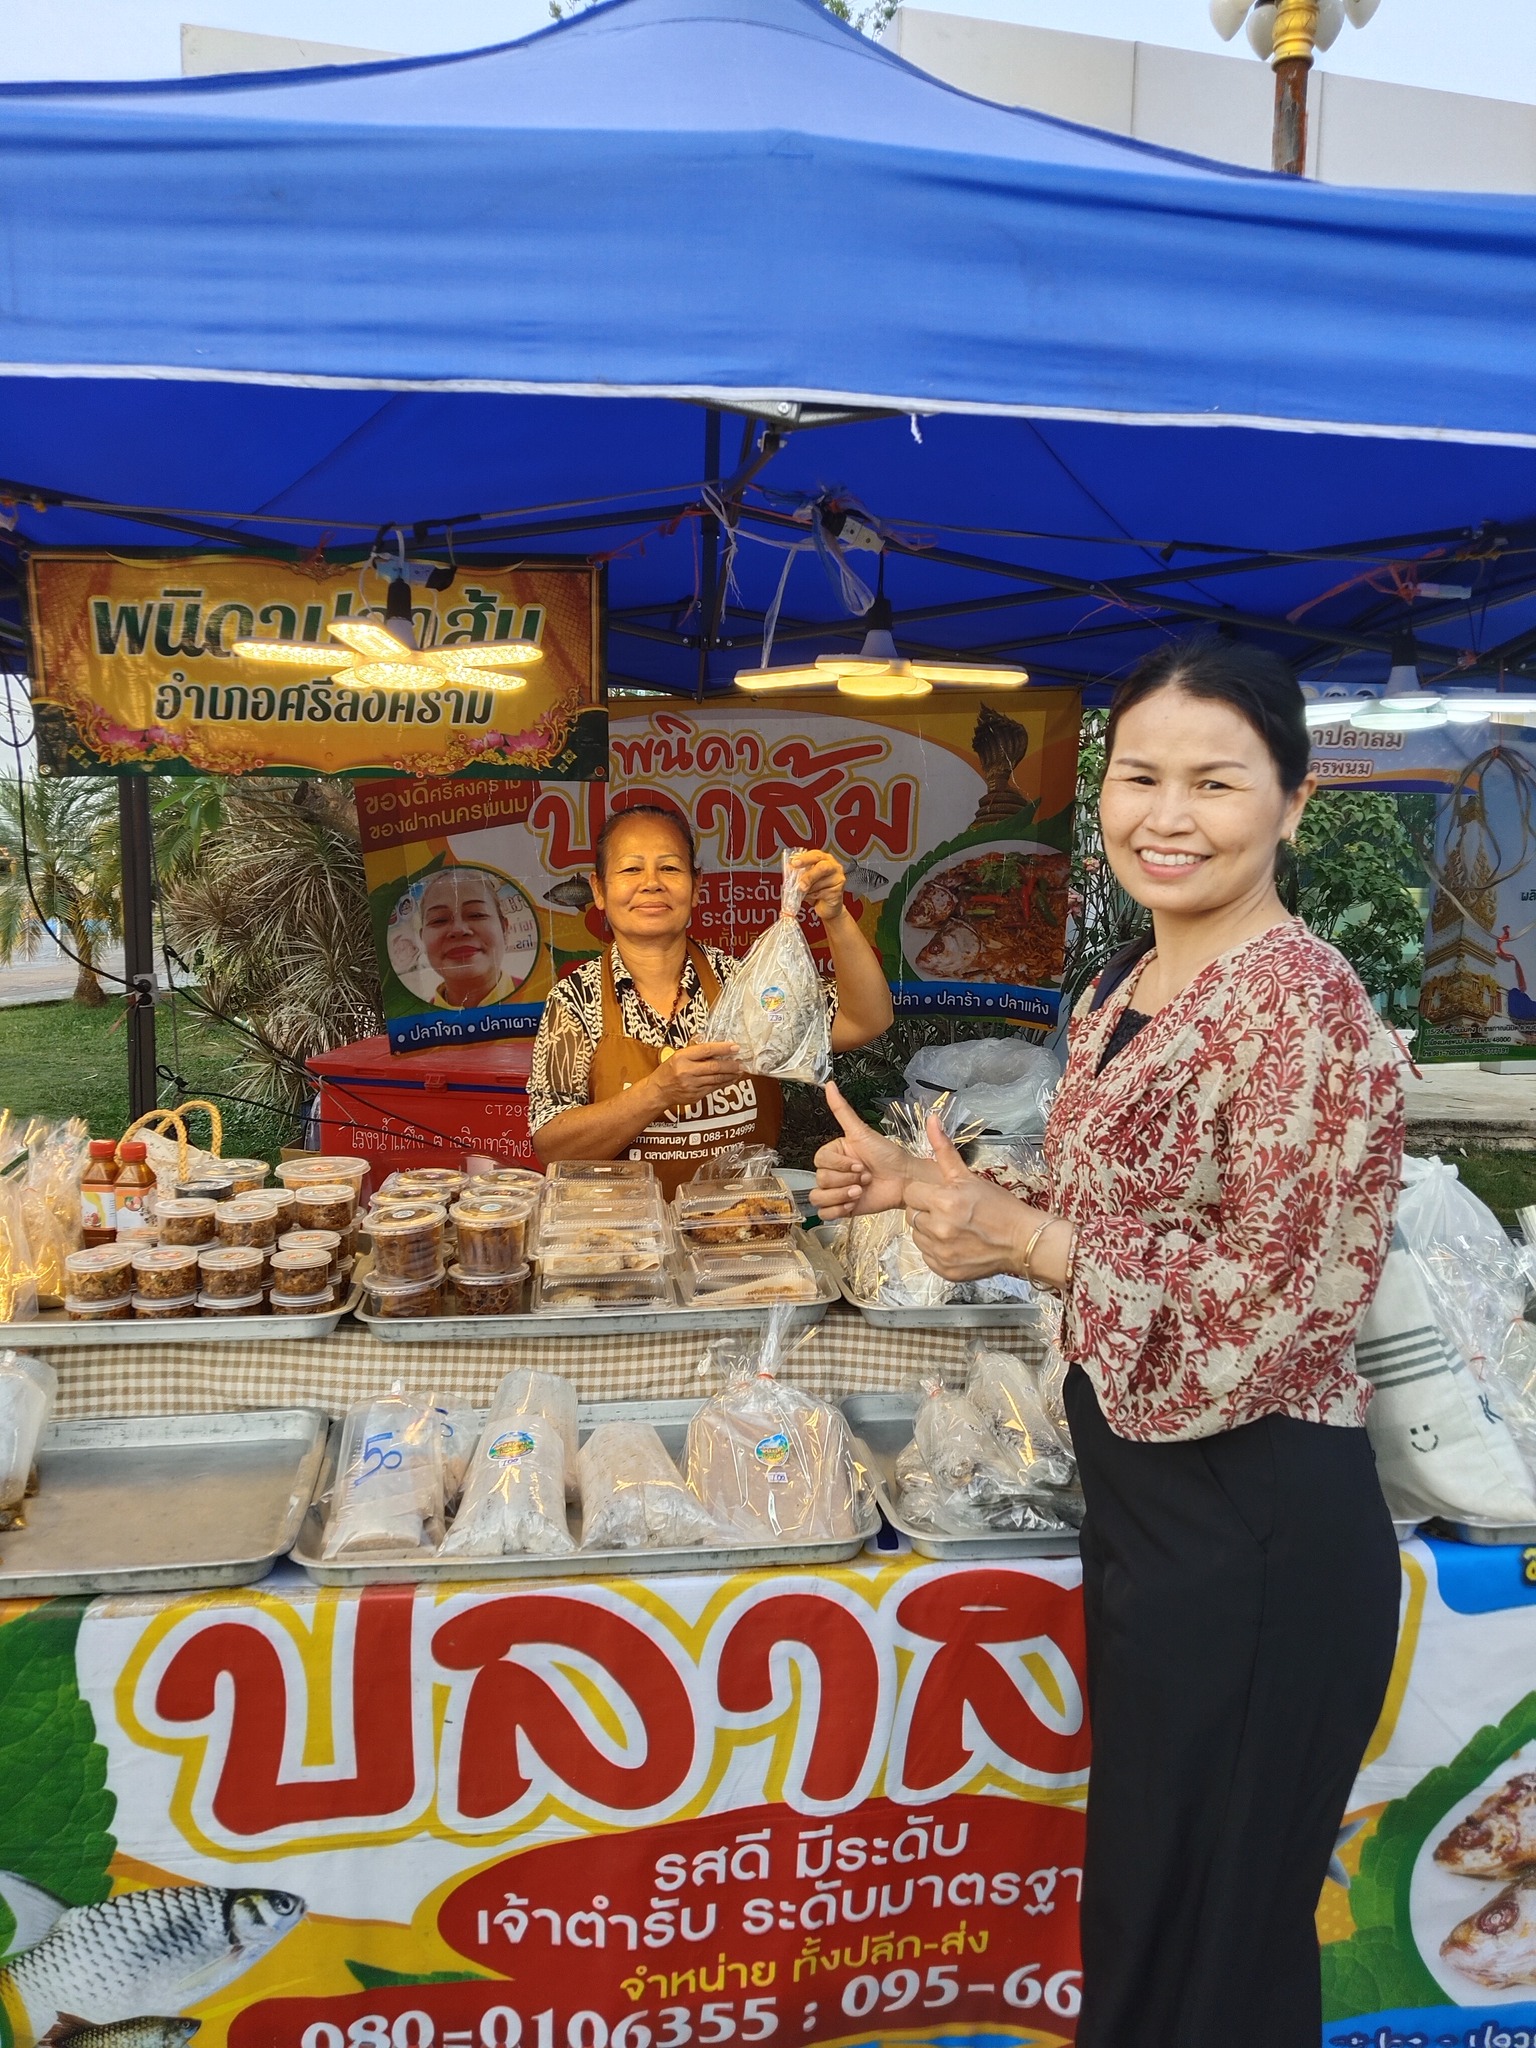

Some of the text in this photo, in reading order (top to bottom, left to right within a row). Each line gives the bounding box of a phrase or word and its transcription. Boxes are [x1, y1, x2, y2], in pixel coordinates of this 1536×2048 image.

[612, 714, 760, 775] พนิดา
[410, 1021, 463, 1041] ปลาโจก
[353, 1431, 402, 1487] 50
[653, 1815, 970, 1892] รสดี มีระดับ
[477, 1894, 717, 1952] เจ้าตำรับ
[620, 1920, 990, 2003] จำหน่าย ทั้งปลีก-ส่ง
